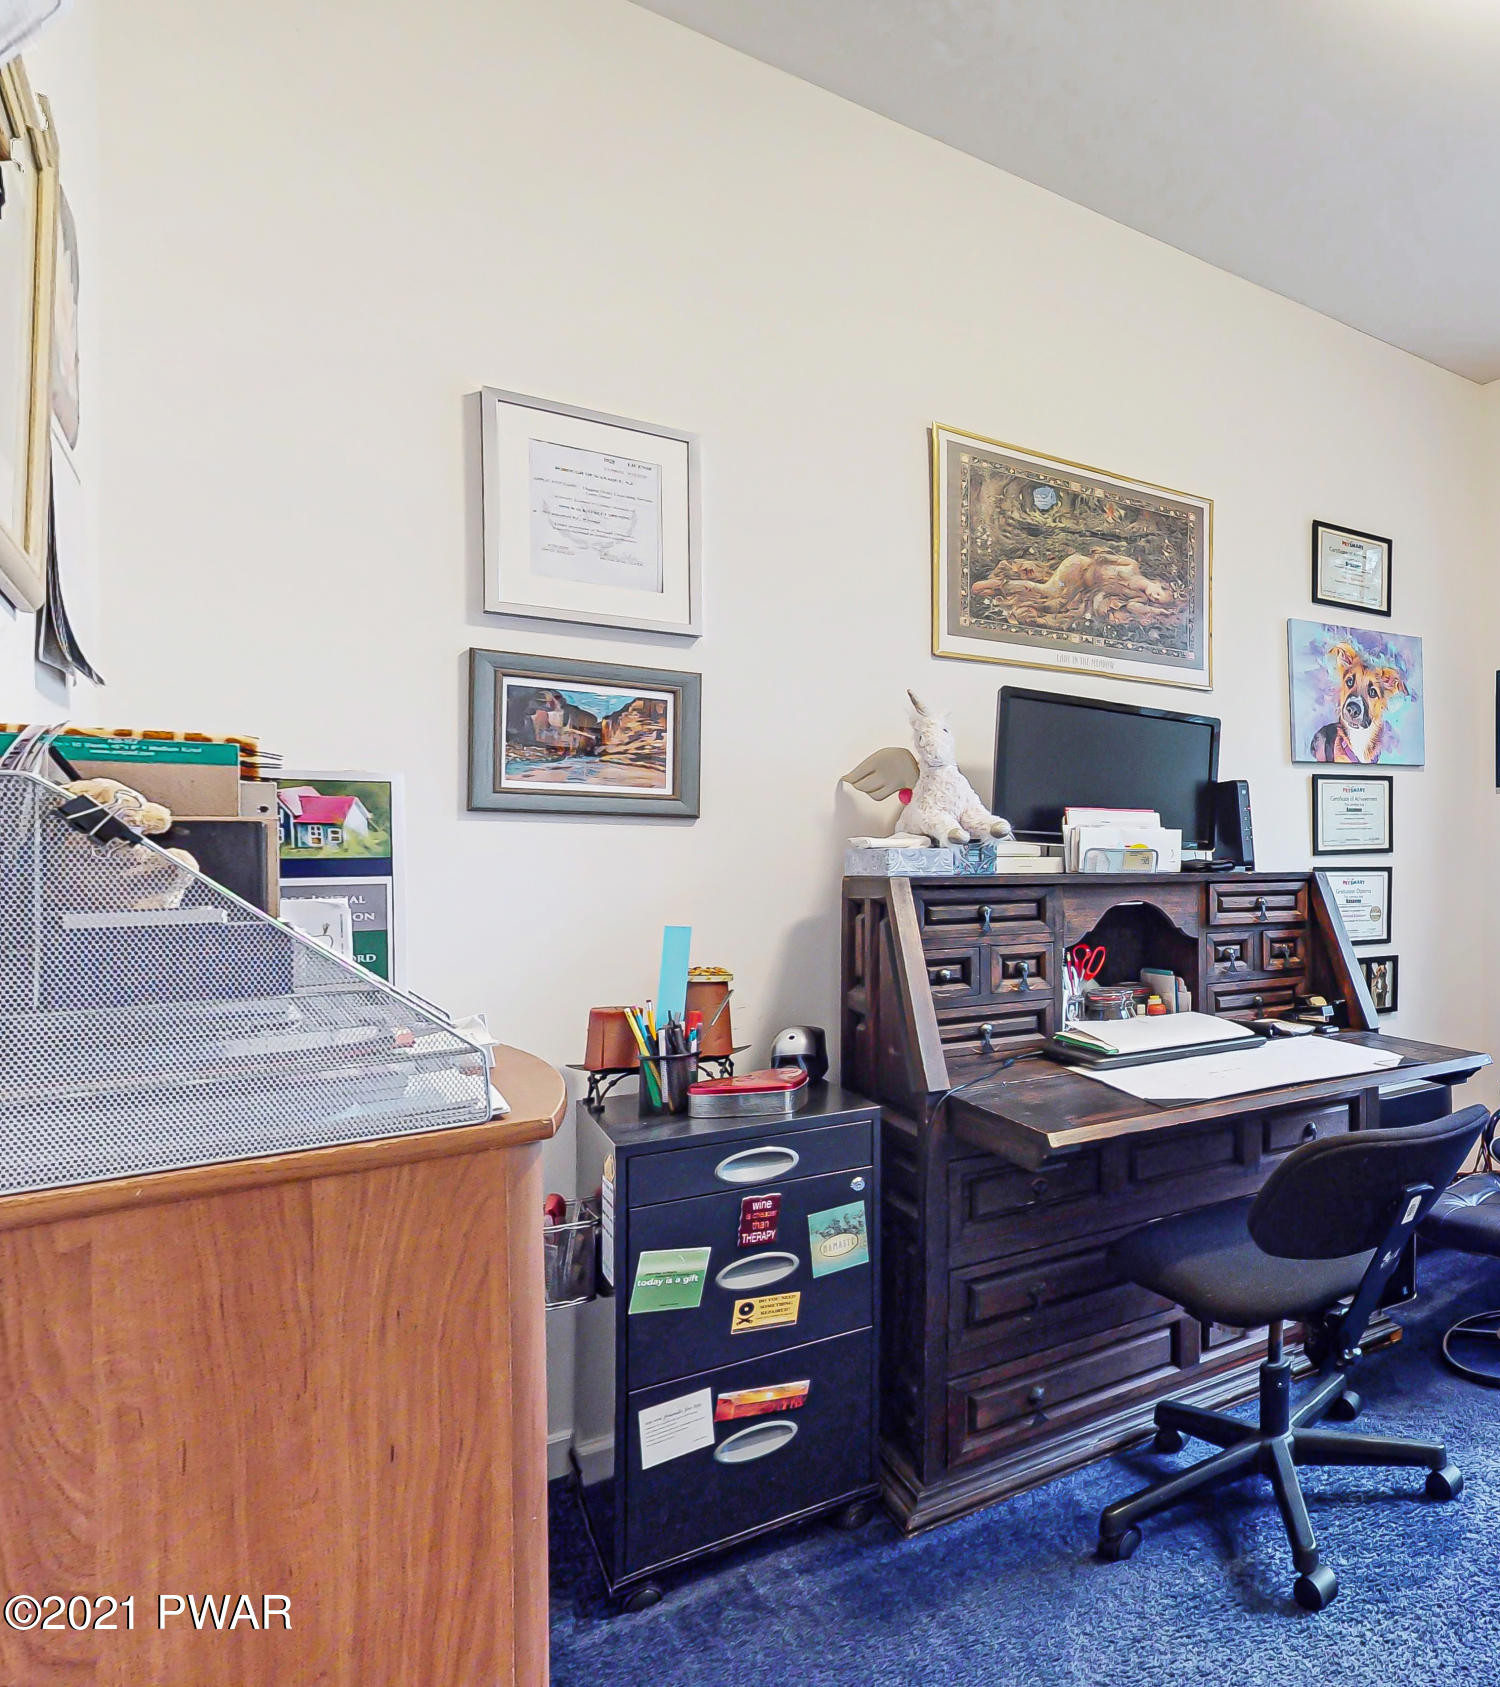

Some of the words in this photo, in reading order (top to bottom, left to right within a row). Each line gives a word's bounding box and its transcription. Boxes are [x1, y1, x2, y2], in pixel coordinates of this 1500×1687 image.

[752, 1200, 773, 1211] wine
[741, 1230, 777, 1244] THERAPY
[637, 1278, 664, 1287] today
[665, 1276, 673, 1284] is
[683, 1273, 699, 1285] gift
